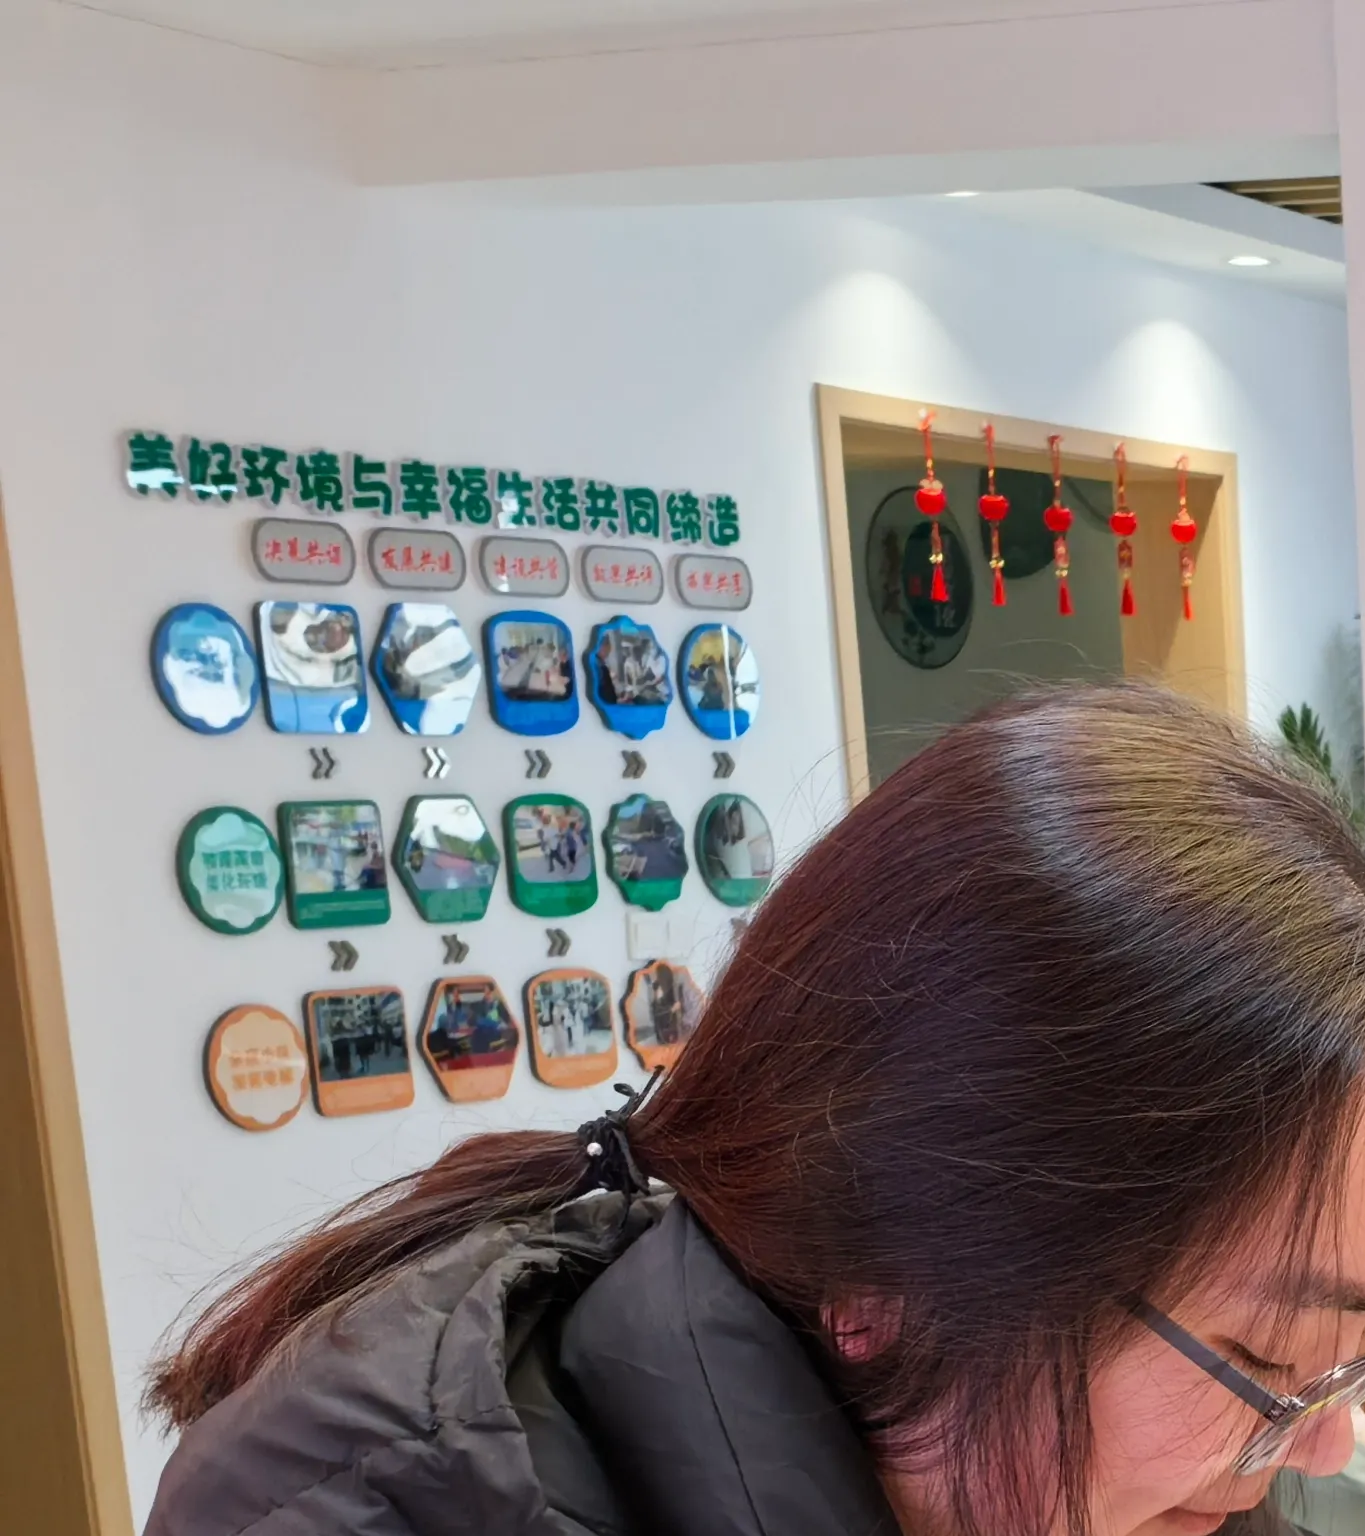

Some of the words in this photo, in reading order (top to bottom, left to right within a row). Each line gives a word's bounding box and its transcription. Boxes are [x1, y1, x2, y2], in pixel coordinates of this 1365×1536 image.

[126, 433, 741, 546] 美好环境与幸福生活共同缔造
